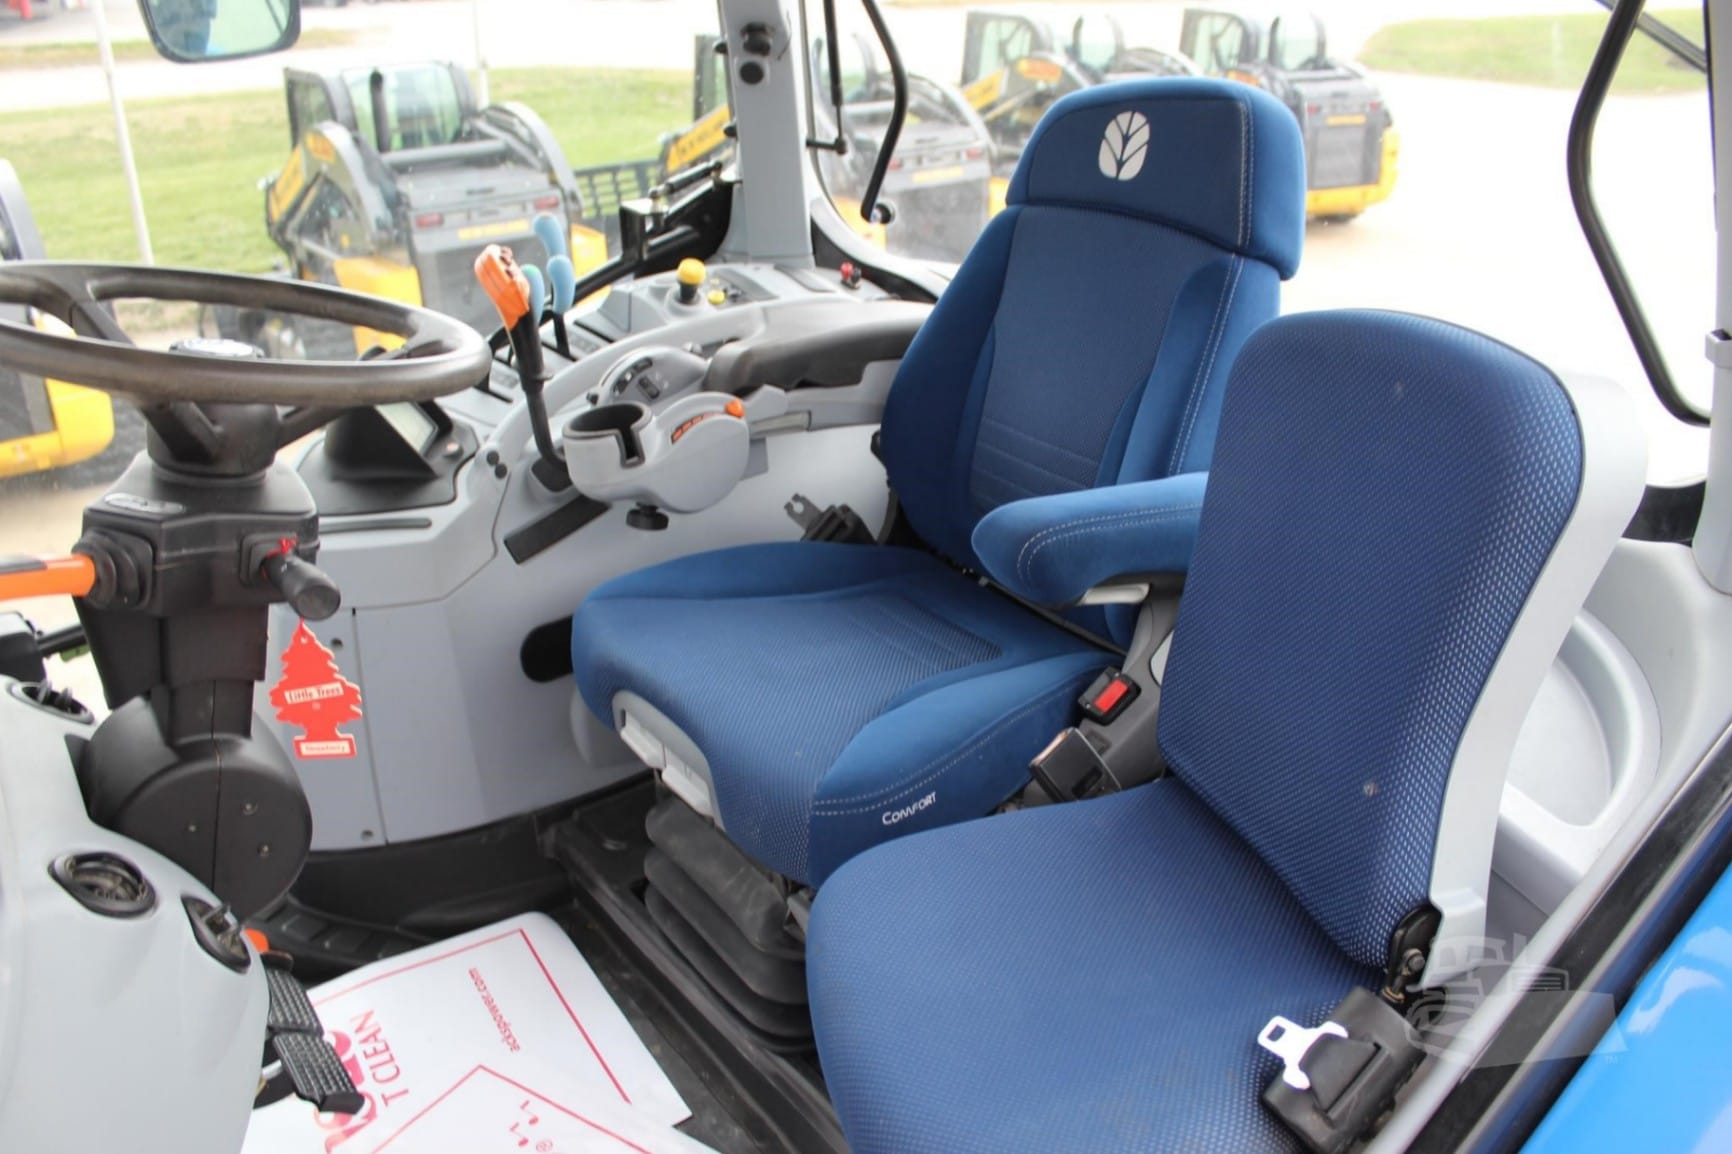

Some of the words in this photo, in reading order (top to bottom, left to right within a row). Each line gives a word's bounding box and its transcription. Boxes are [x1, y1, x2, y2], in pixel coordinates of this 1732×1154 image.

[288, 688, 314, 703] Little
[316, 685, 341, 699] Trees
[350, 1010, 400, 1084] CLEAN
